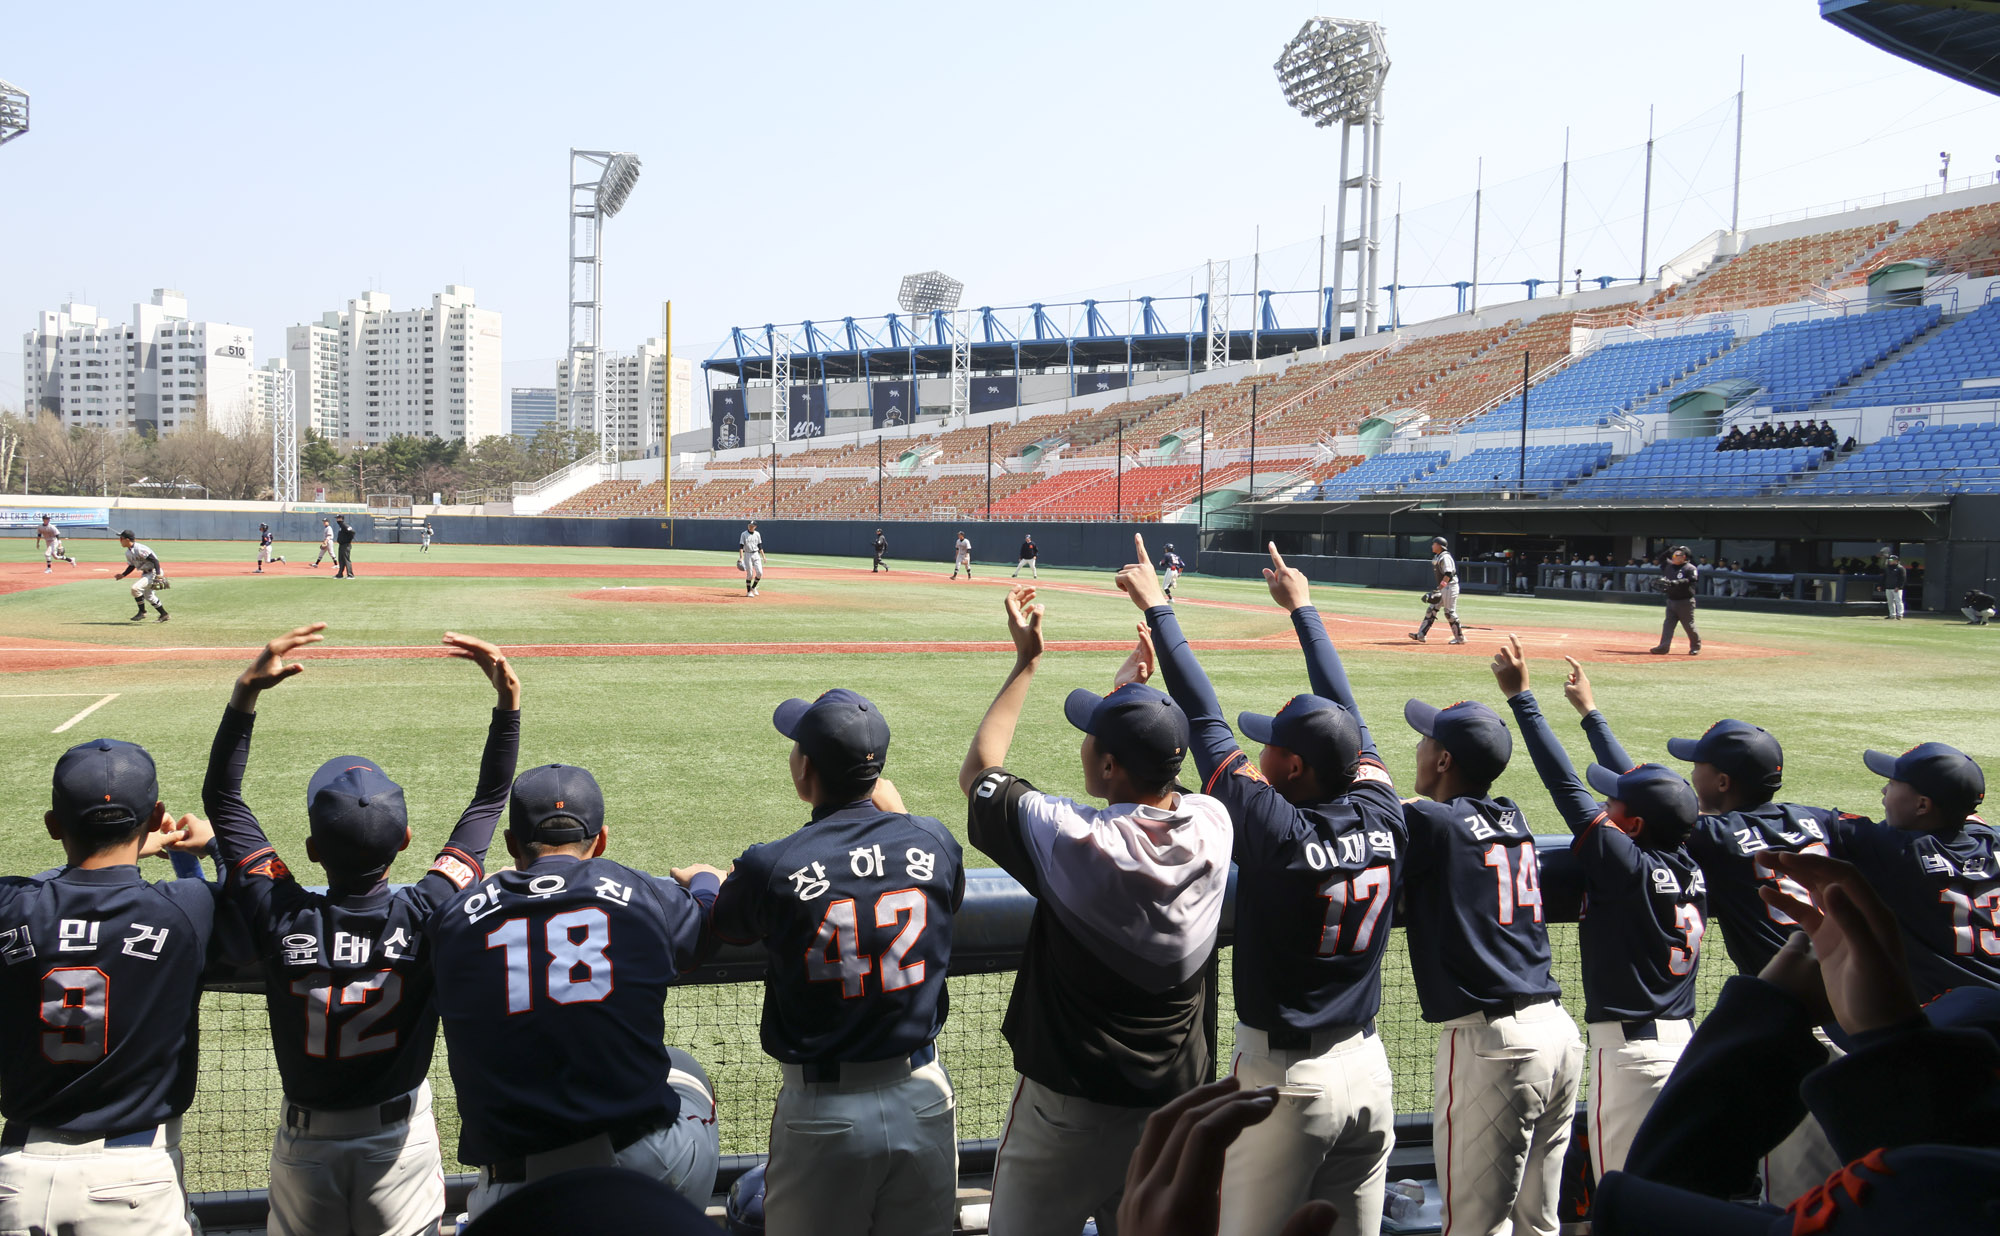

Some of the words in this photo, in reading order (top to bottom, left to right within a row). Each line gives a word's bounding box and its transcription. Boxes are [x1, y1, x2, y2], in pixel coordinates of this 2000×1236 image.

[228, 345, 245, 356] 510
[1305, 830, 1396, 870] 이재혁
[1464, 811, 1532, 840] 김범
[464, 875, 632, 924] 안우진
[788, 844, 935, 901] 장하영
[1485, 841, 1542, 925] 14
[0, 918, 169, 966] 김민건
[804, 887, 927, 999] 42
[1315, 864, 1391, 957] 17
[1667, 902, 1706, 976] 3
[1939, 887, 2000, 956] 13
[485, 906, 615, 1016] 18
[40, 966, 110, 1064] 9
[289, 967, 404, 1060] 12
